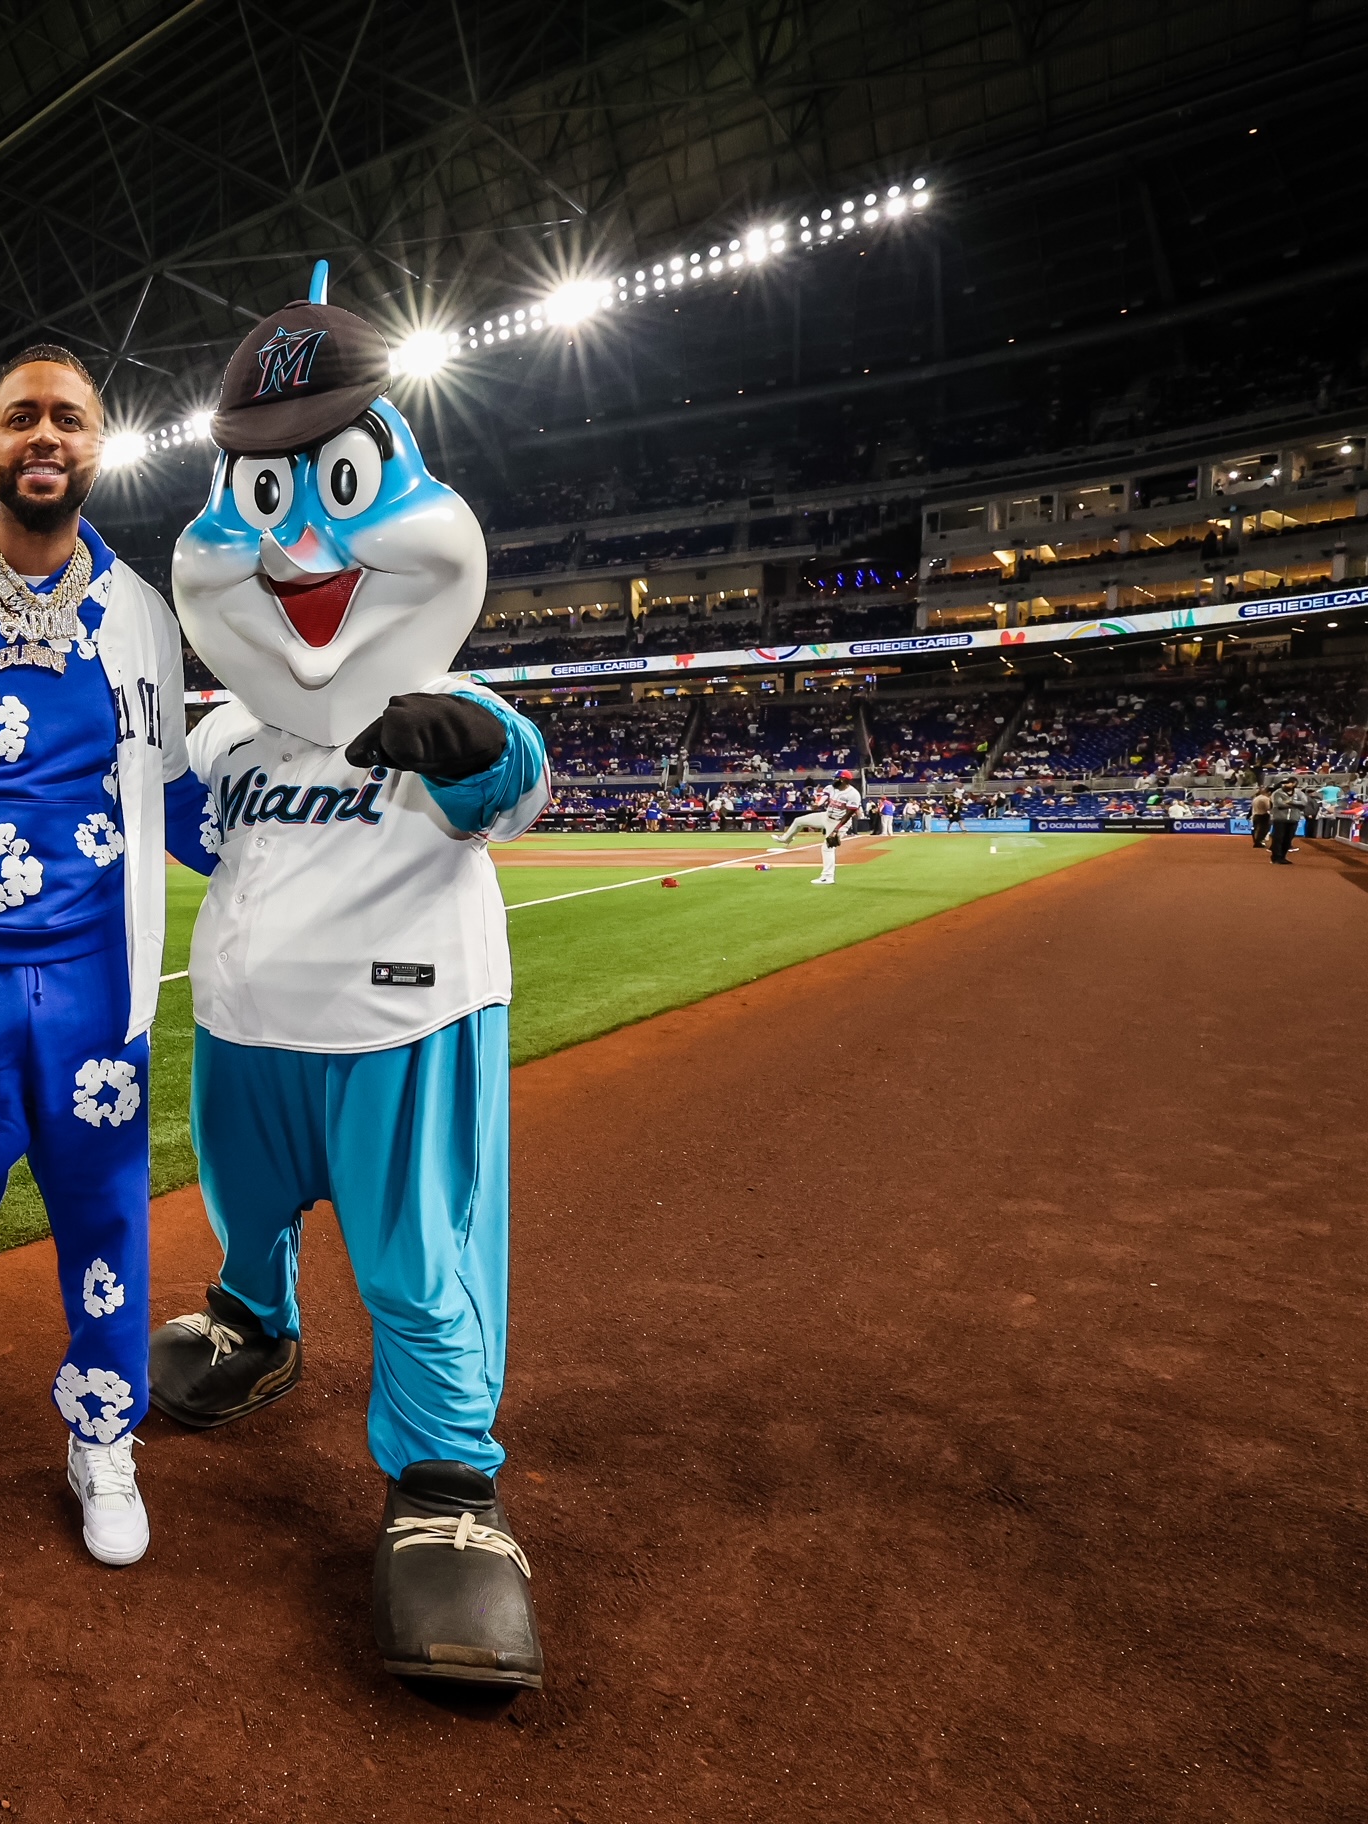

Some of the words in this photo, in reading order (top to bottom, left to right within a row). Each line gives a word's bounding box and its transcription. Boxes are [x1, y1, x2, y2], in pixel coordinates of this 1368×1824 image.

[852, 635, 969, 653] SERIEDELCARIBE
[554, 660, 645, 675] SERIEDELCARIBE
[221, 765, 384, 832] Miami
[1077, 822, 1100, 830] BANK
[1182, 822, 1206, 830] OCEAN
[1206, 821, 1226, 829] BANK
